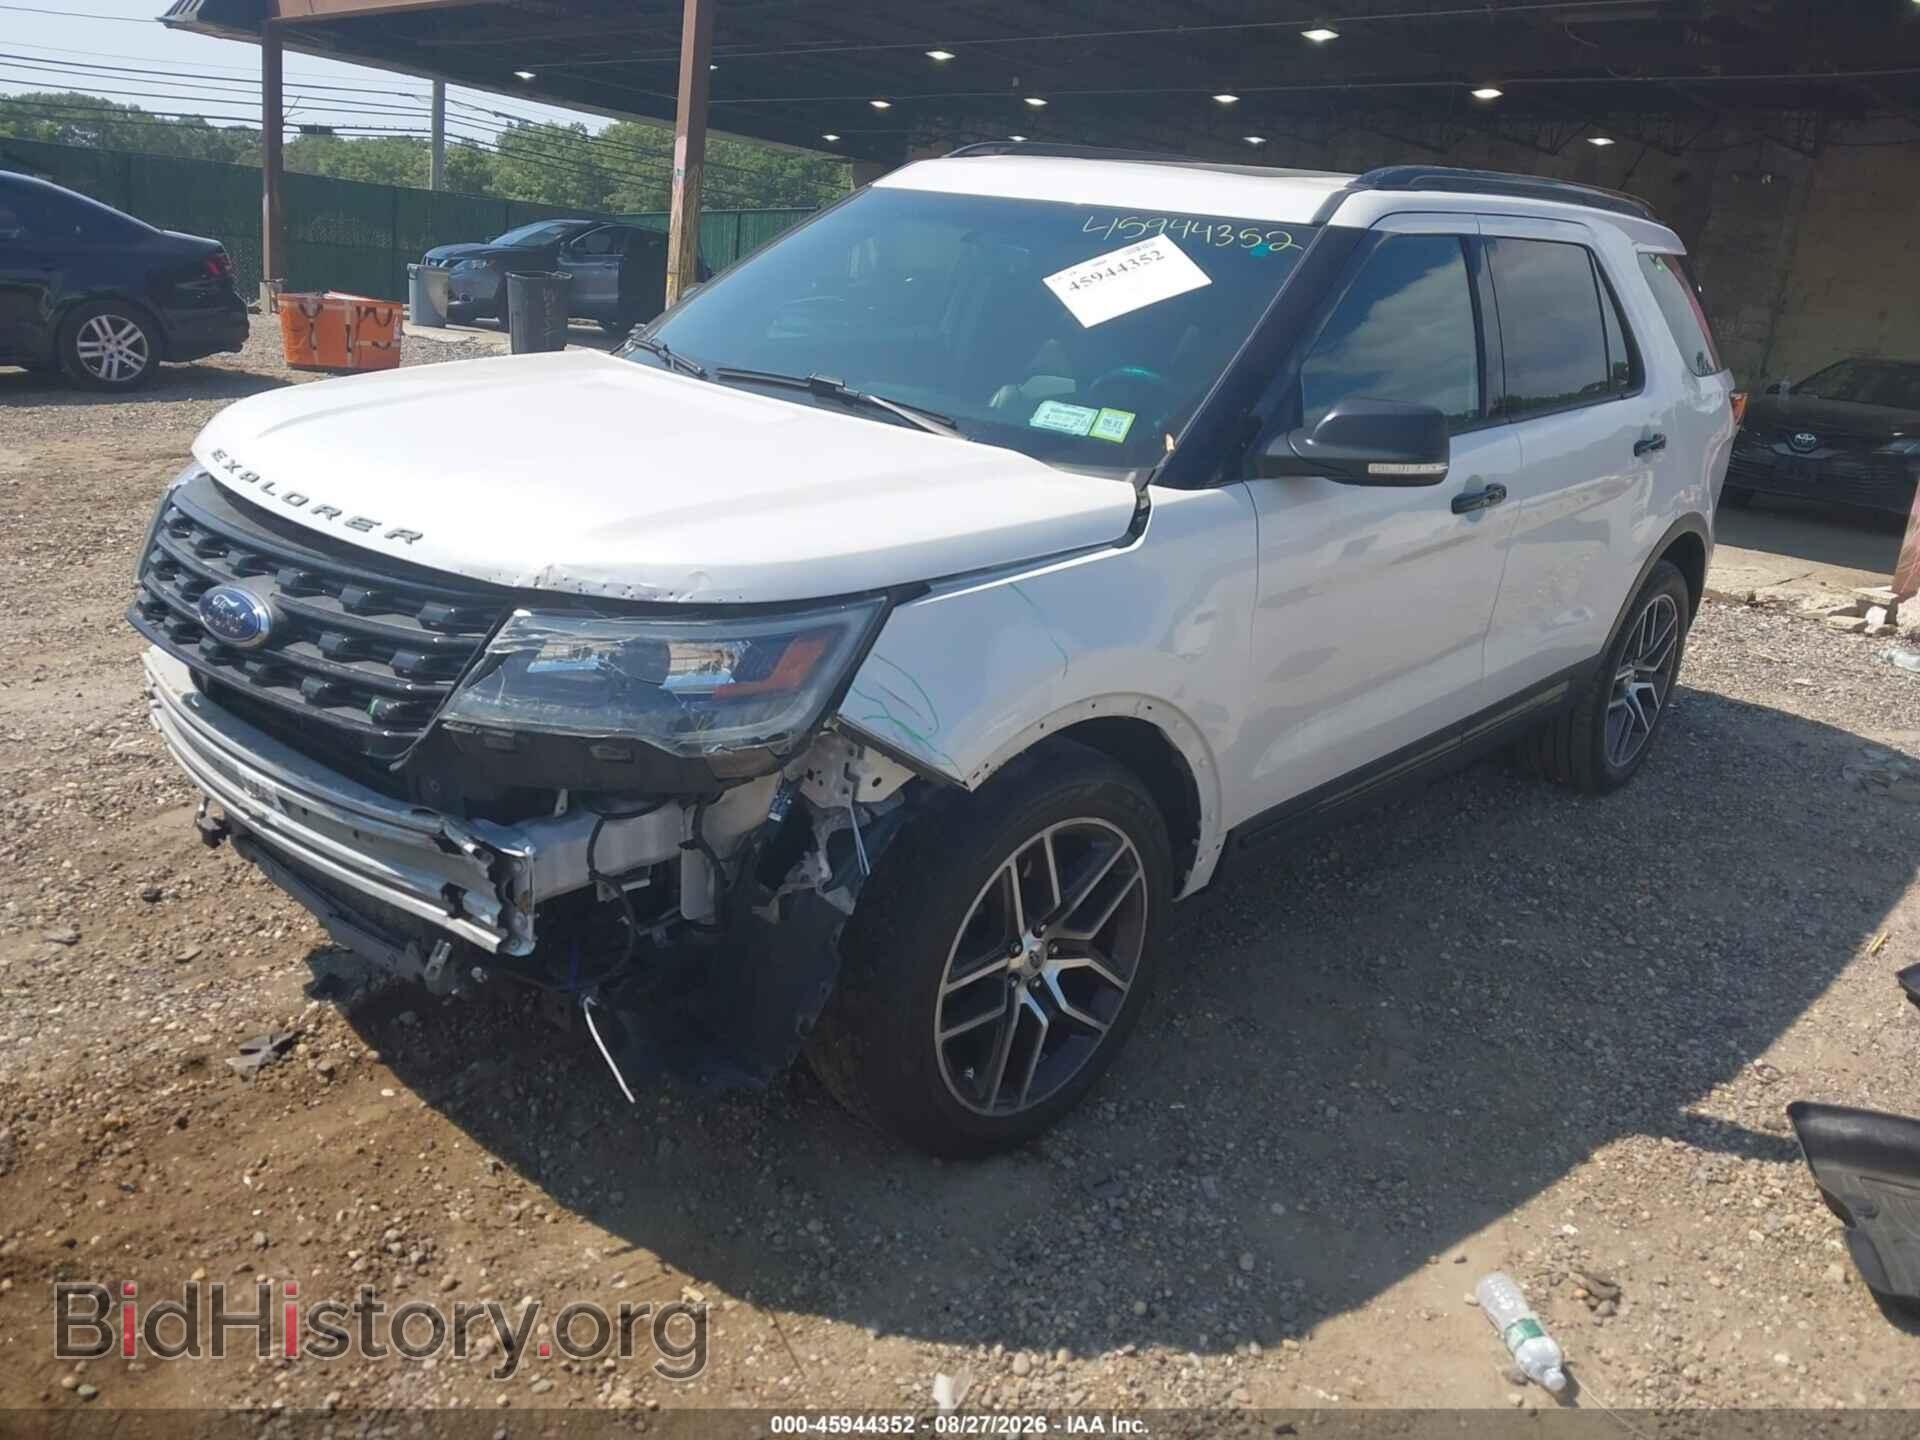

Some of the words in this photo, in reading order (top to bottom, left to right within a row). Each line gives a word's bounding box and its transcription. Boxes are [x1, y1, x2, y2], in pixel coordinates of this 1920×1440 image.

[1082, 215, 1303, 251] 45944352
[1068, 249, 1166, 291] 45944352
[211, 448, 424, 545] EXPLORER
